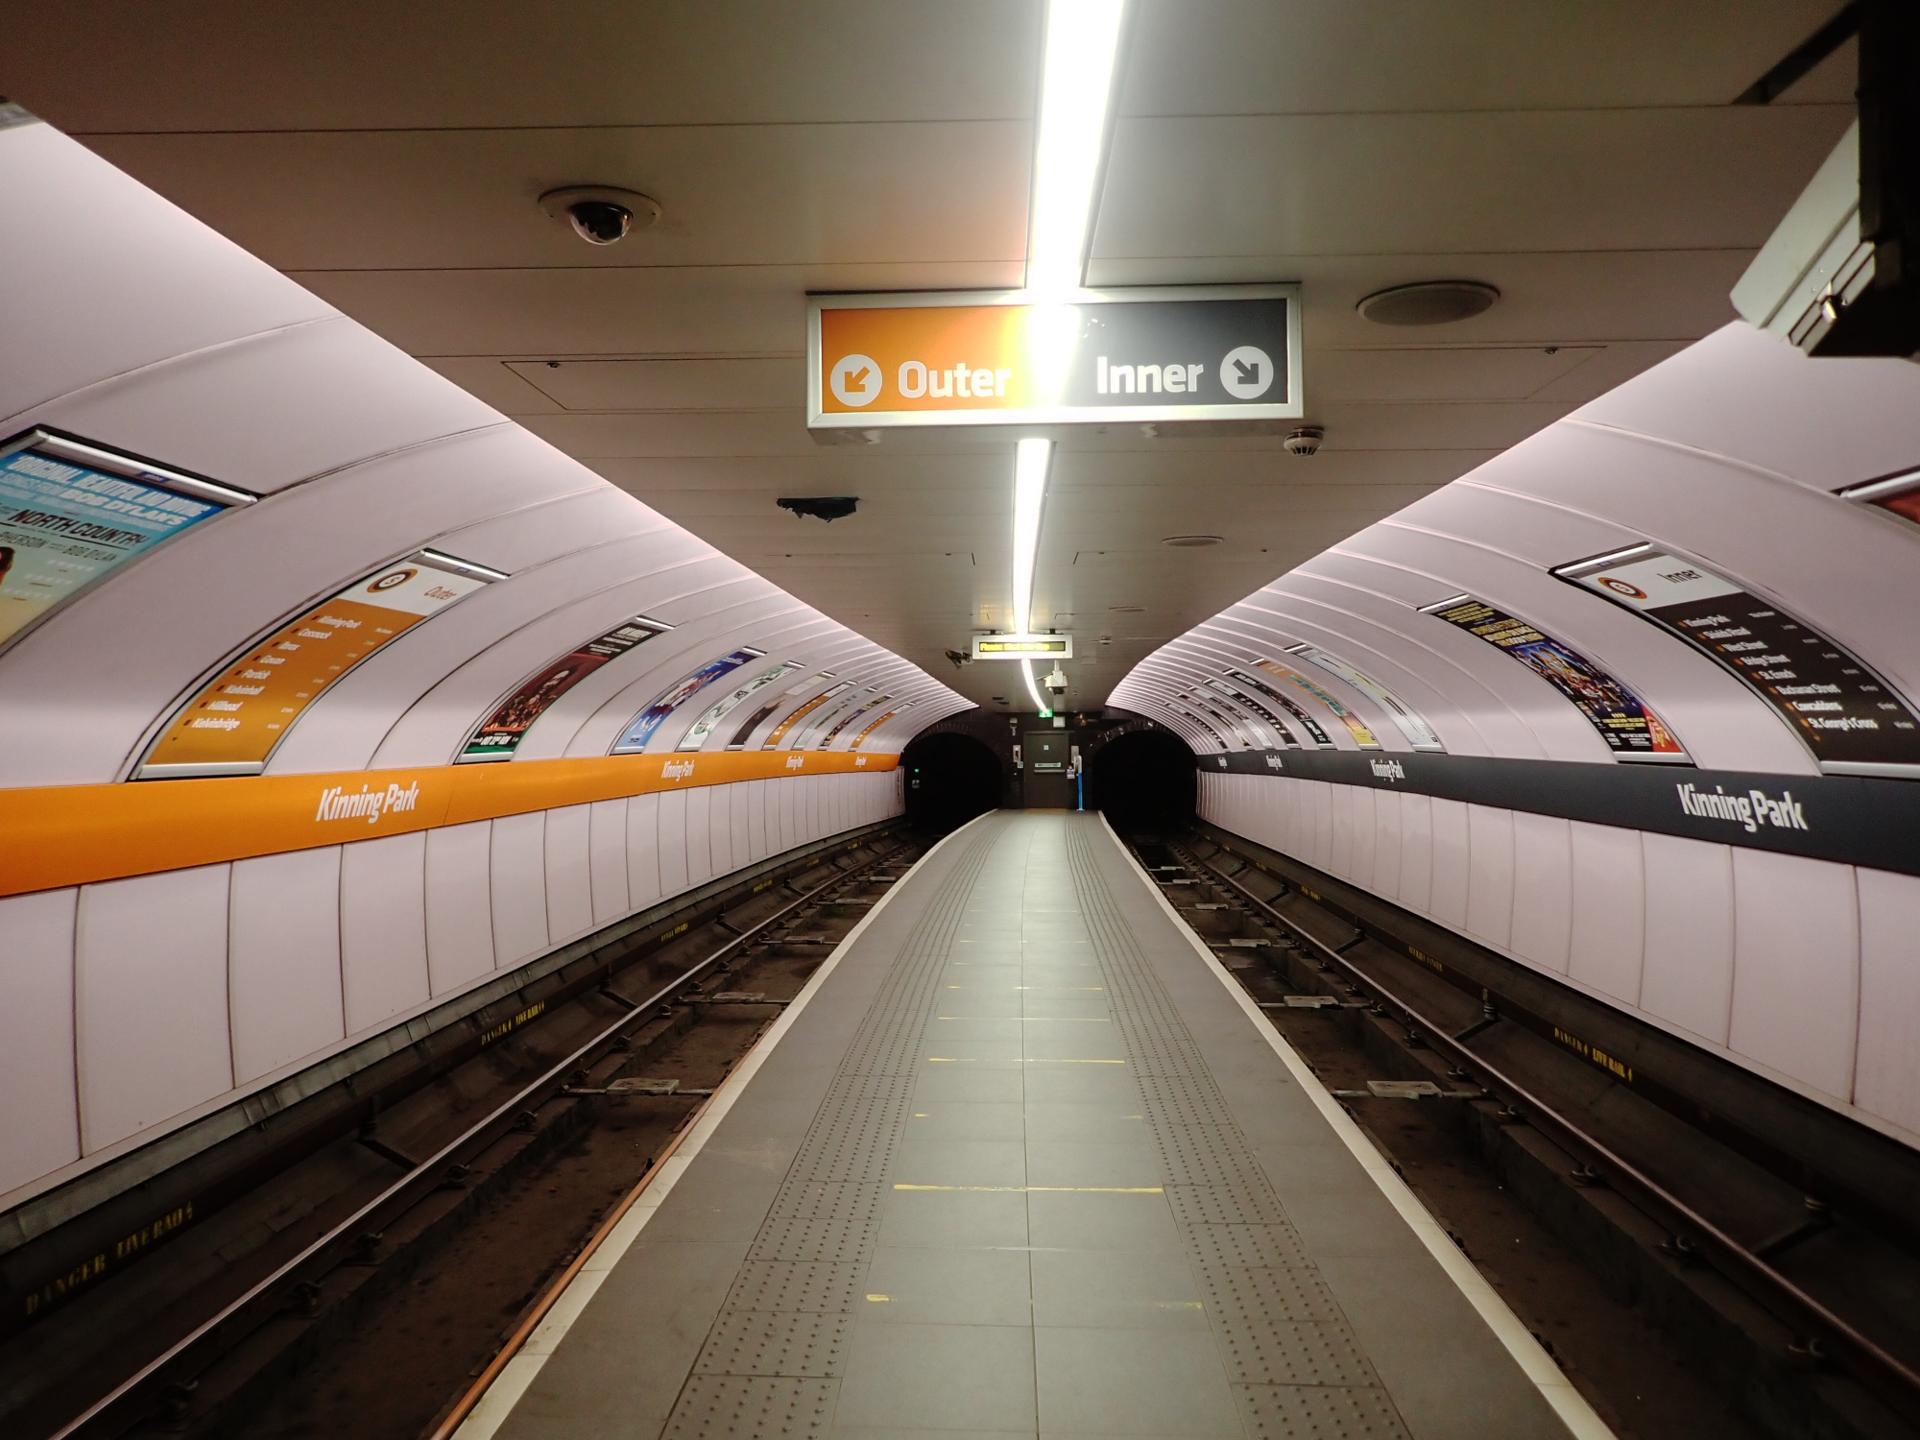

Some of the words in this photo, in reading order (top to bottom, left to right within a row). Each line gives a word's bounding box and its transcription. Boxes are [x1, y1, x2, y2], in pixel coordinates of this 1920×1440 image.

[898, 359, 1012, 399] Outer
[1097, 356, 1204, 395] Inner
[8, 508, 72, 532] NORTH
[70, 521, 151, 546] COUNTRY
[1656, 569, 1702, 584] Inner
[315, 775, 386, 824] Kinning
[382, 780, 420, 814] Park
[1676, 782, 1758, 833] Kinning
[1748, 789, 1809, 831] Park
